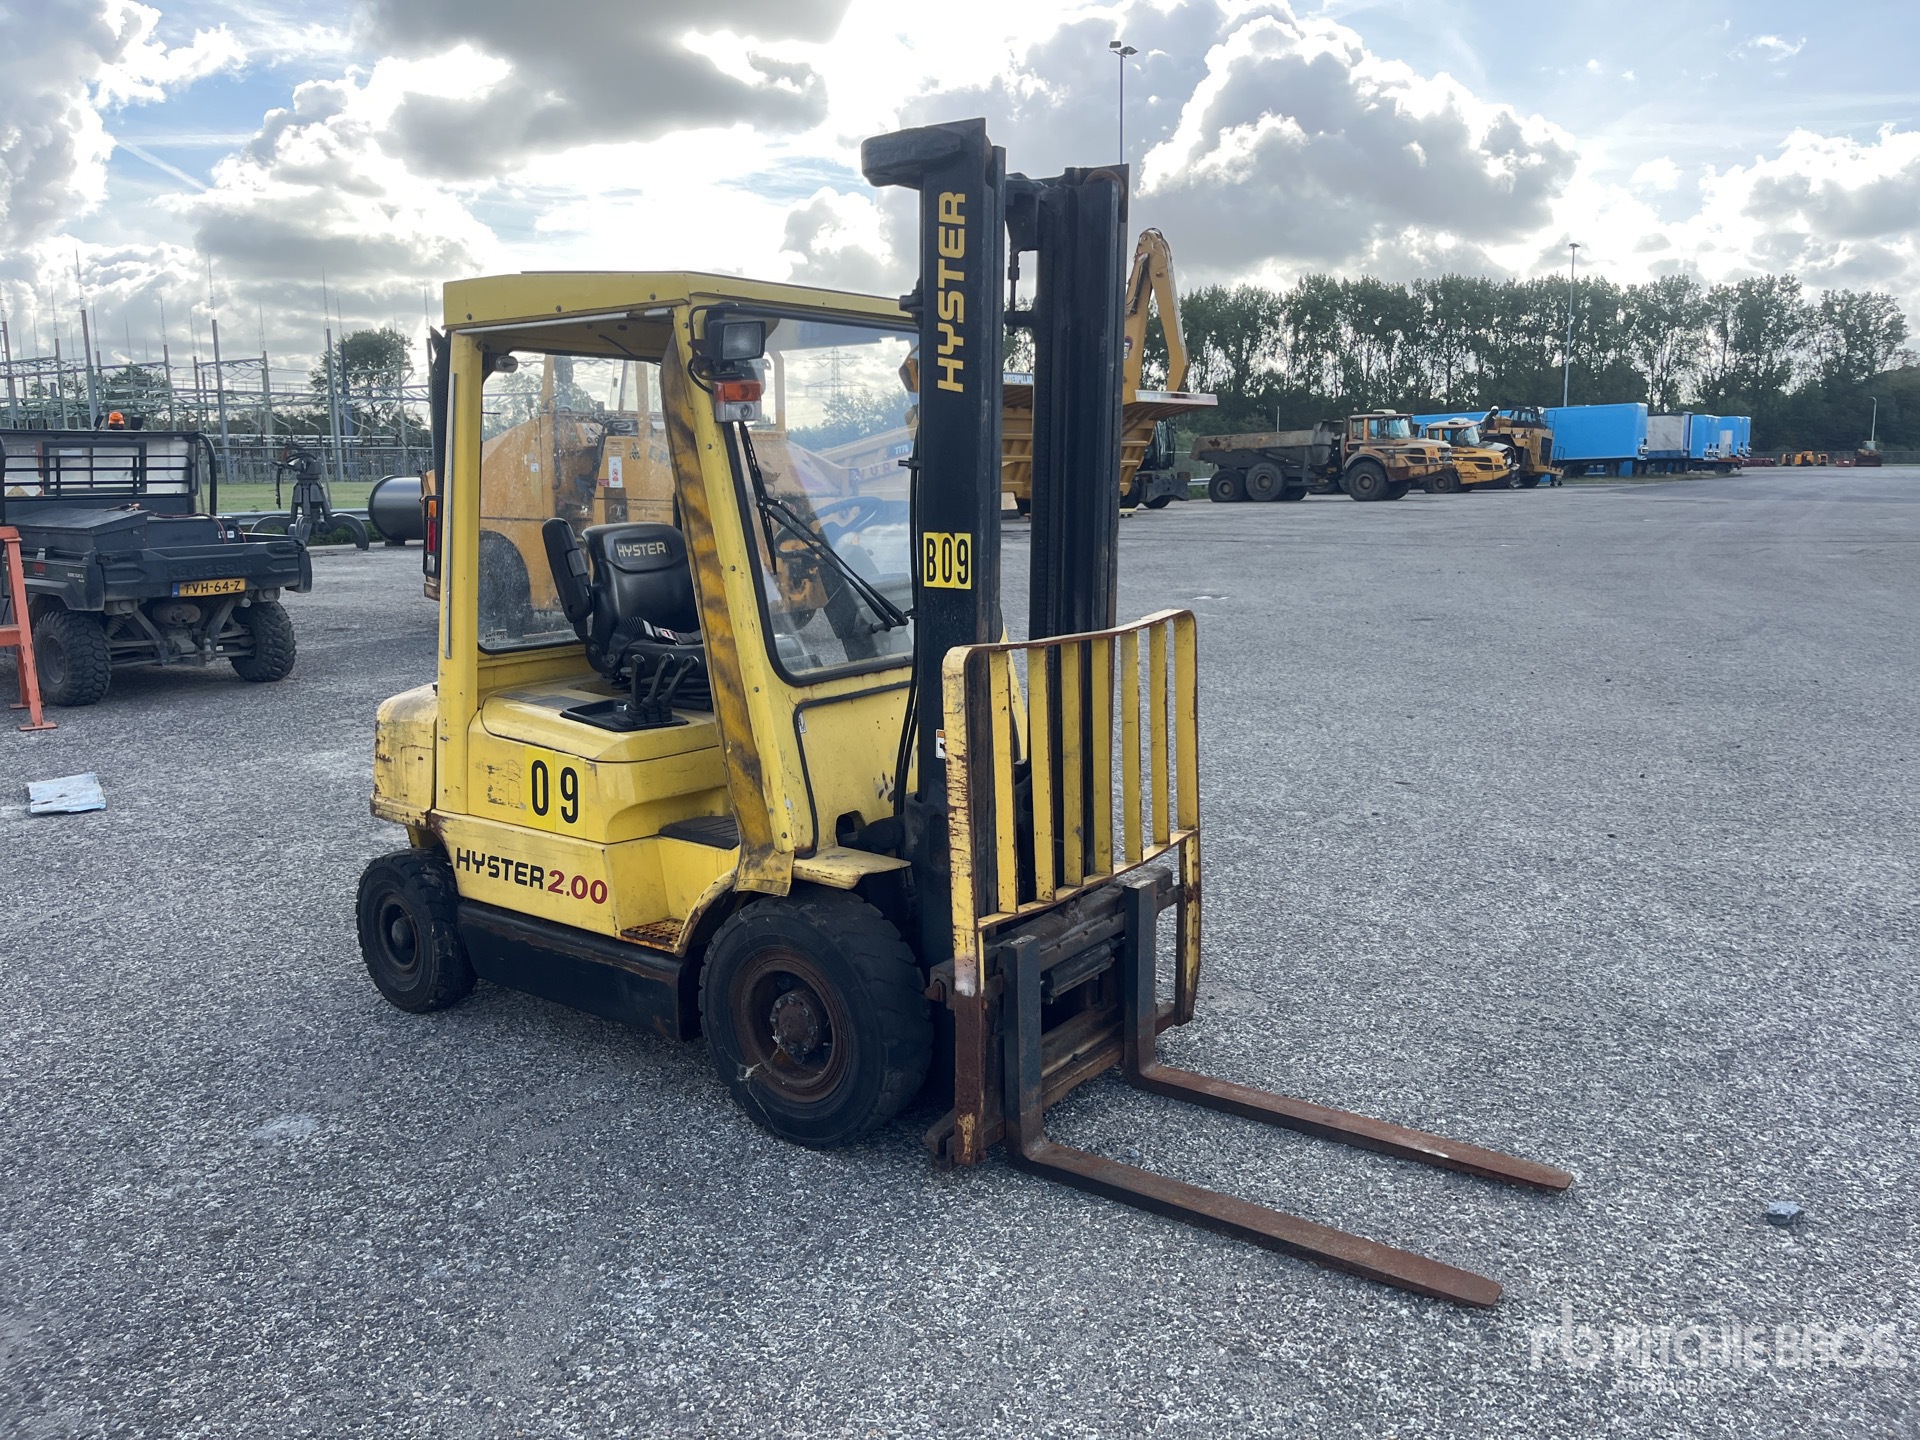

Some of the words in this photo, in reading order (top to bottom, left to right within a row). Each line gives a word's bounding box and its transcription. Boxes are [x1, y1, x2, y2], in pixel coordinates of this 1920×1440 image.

[937, 191, 966, 393] HYSTER
[616, 541, 667, 558] HYSTER
[926, 537, 969, 585] B09
[184, 580, 241, 594] TVH-64-Z
[531, 759, 579, 824] 09
[456, 847, 545, 890] HYSTER
[547, 869, 608, 905] 2.00
